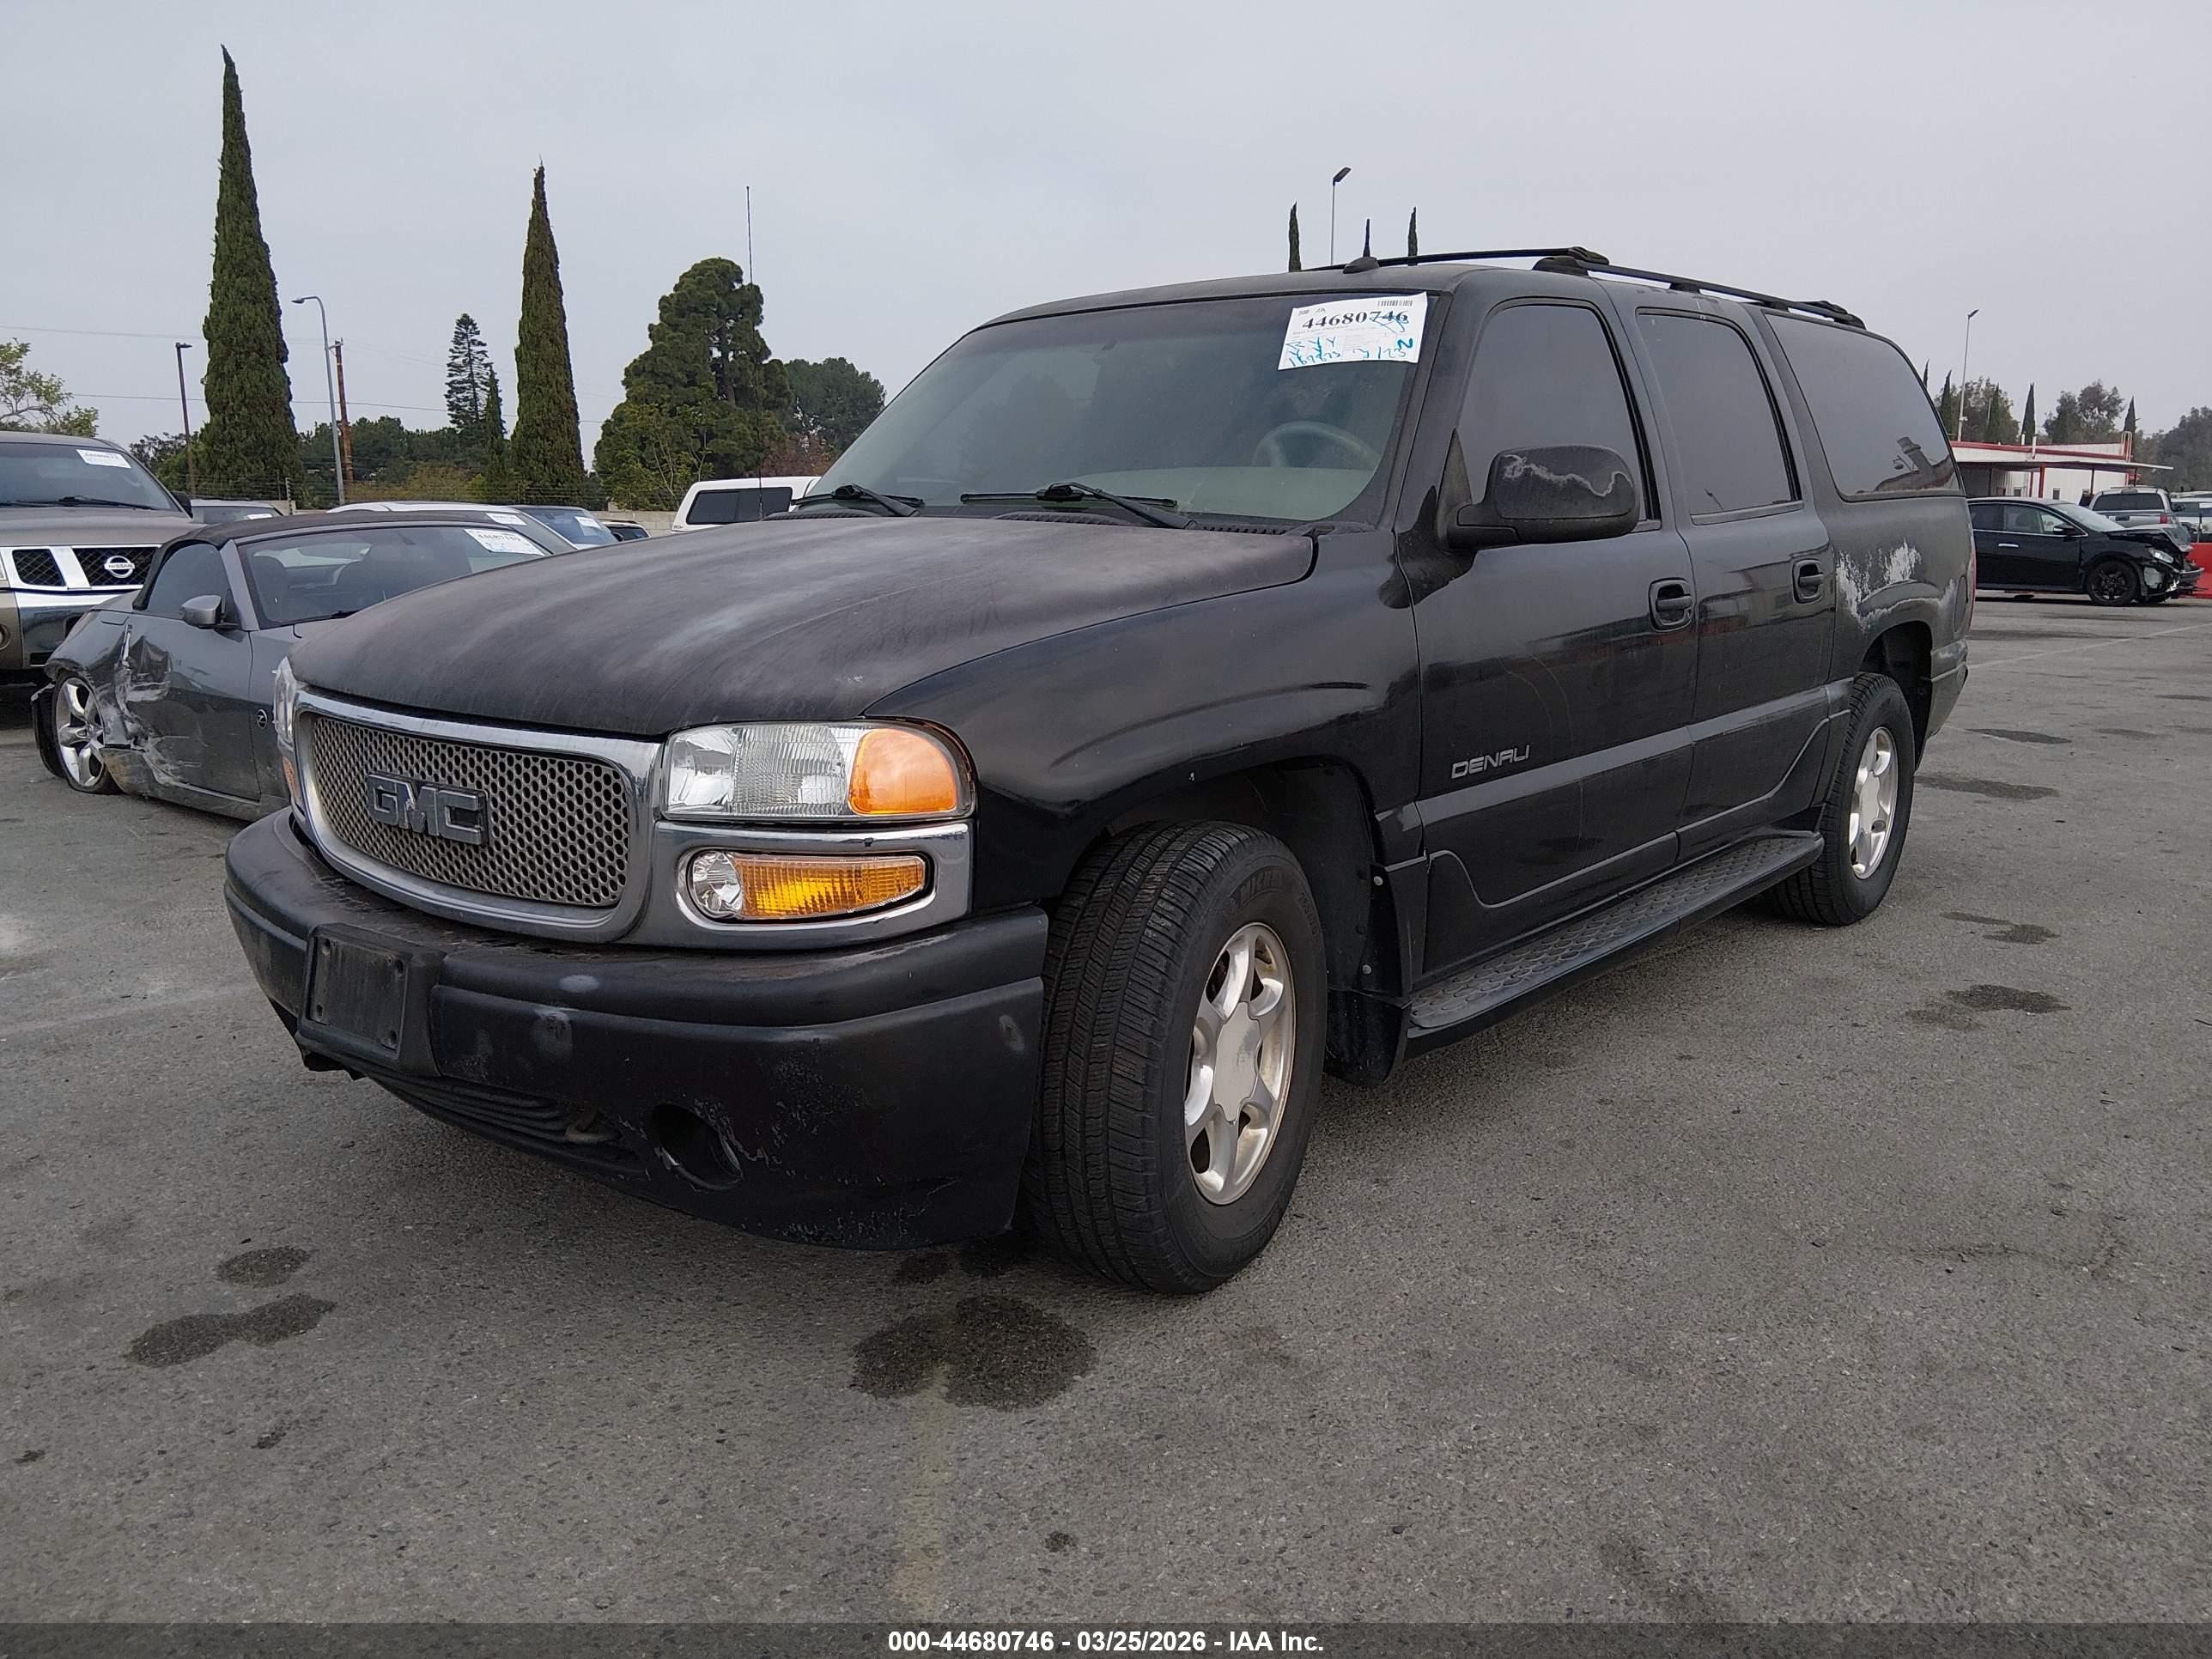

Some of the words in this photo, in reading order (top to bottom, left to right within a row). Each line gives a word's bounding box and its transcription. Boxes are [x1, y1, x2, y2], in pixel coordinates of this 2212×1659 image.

[1302, 310, 1408, 329] 44680746
[1451, 744, 1530, 779] DENALI
[368, 774, 488, 845] GMC
